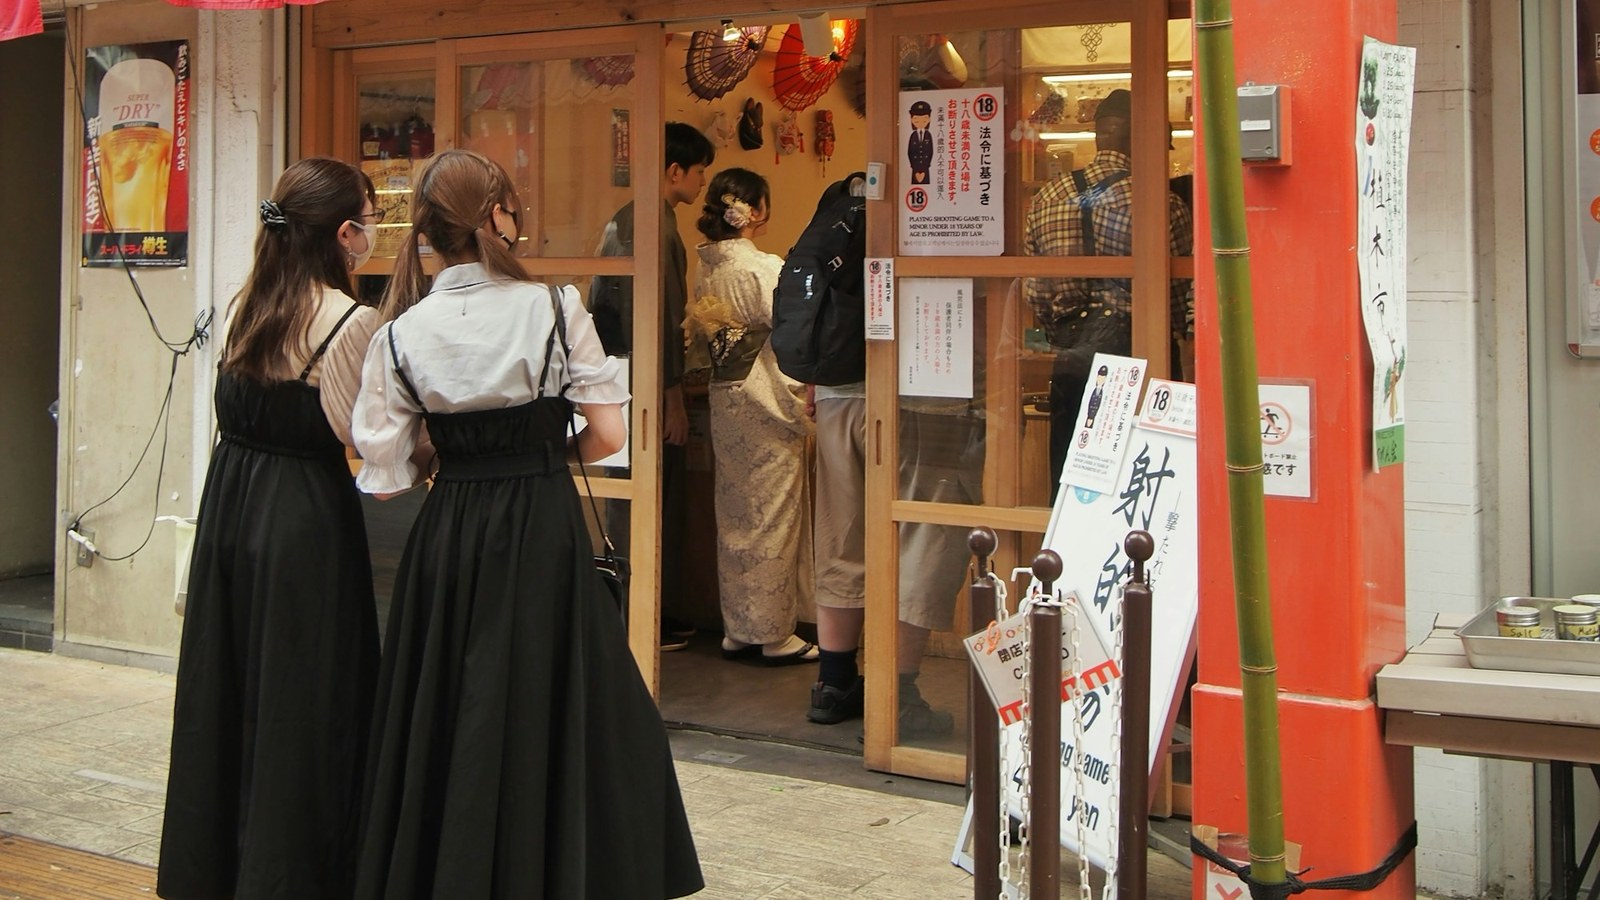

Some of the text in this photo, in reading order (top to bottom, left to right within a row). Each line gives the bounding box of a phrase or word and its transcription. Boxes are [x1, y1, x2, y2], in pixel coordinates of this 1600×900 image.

[977, 98, 994, 114] 18
[960, 99, 971, 192] 十八歳未満の入場は
[979, 126, 992, 206] 法令に基づき
[910, 191, 925, 205] 18
[1129, 368, 1140, 381] 18
[1152, 389, 1169, 411] 18
[1080, 432, 1088, 444] 18
